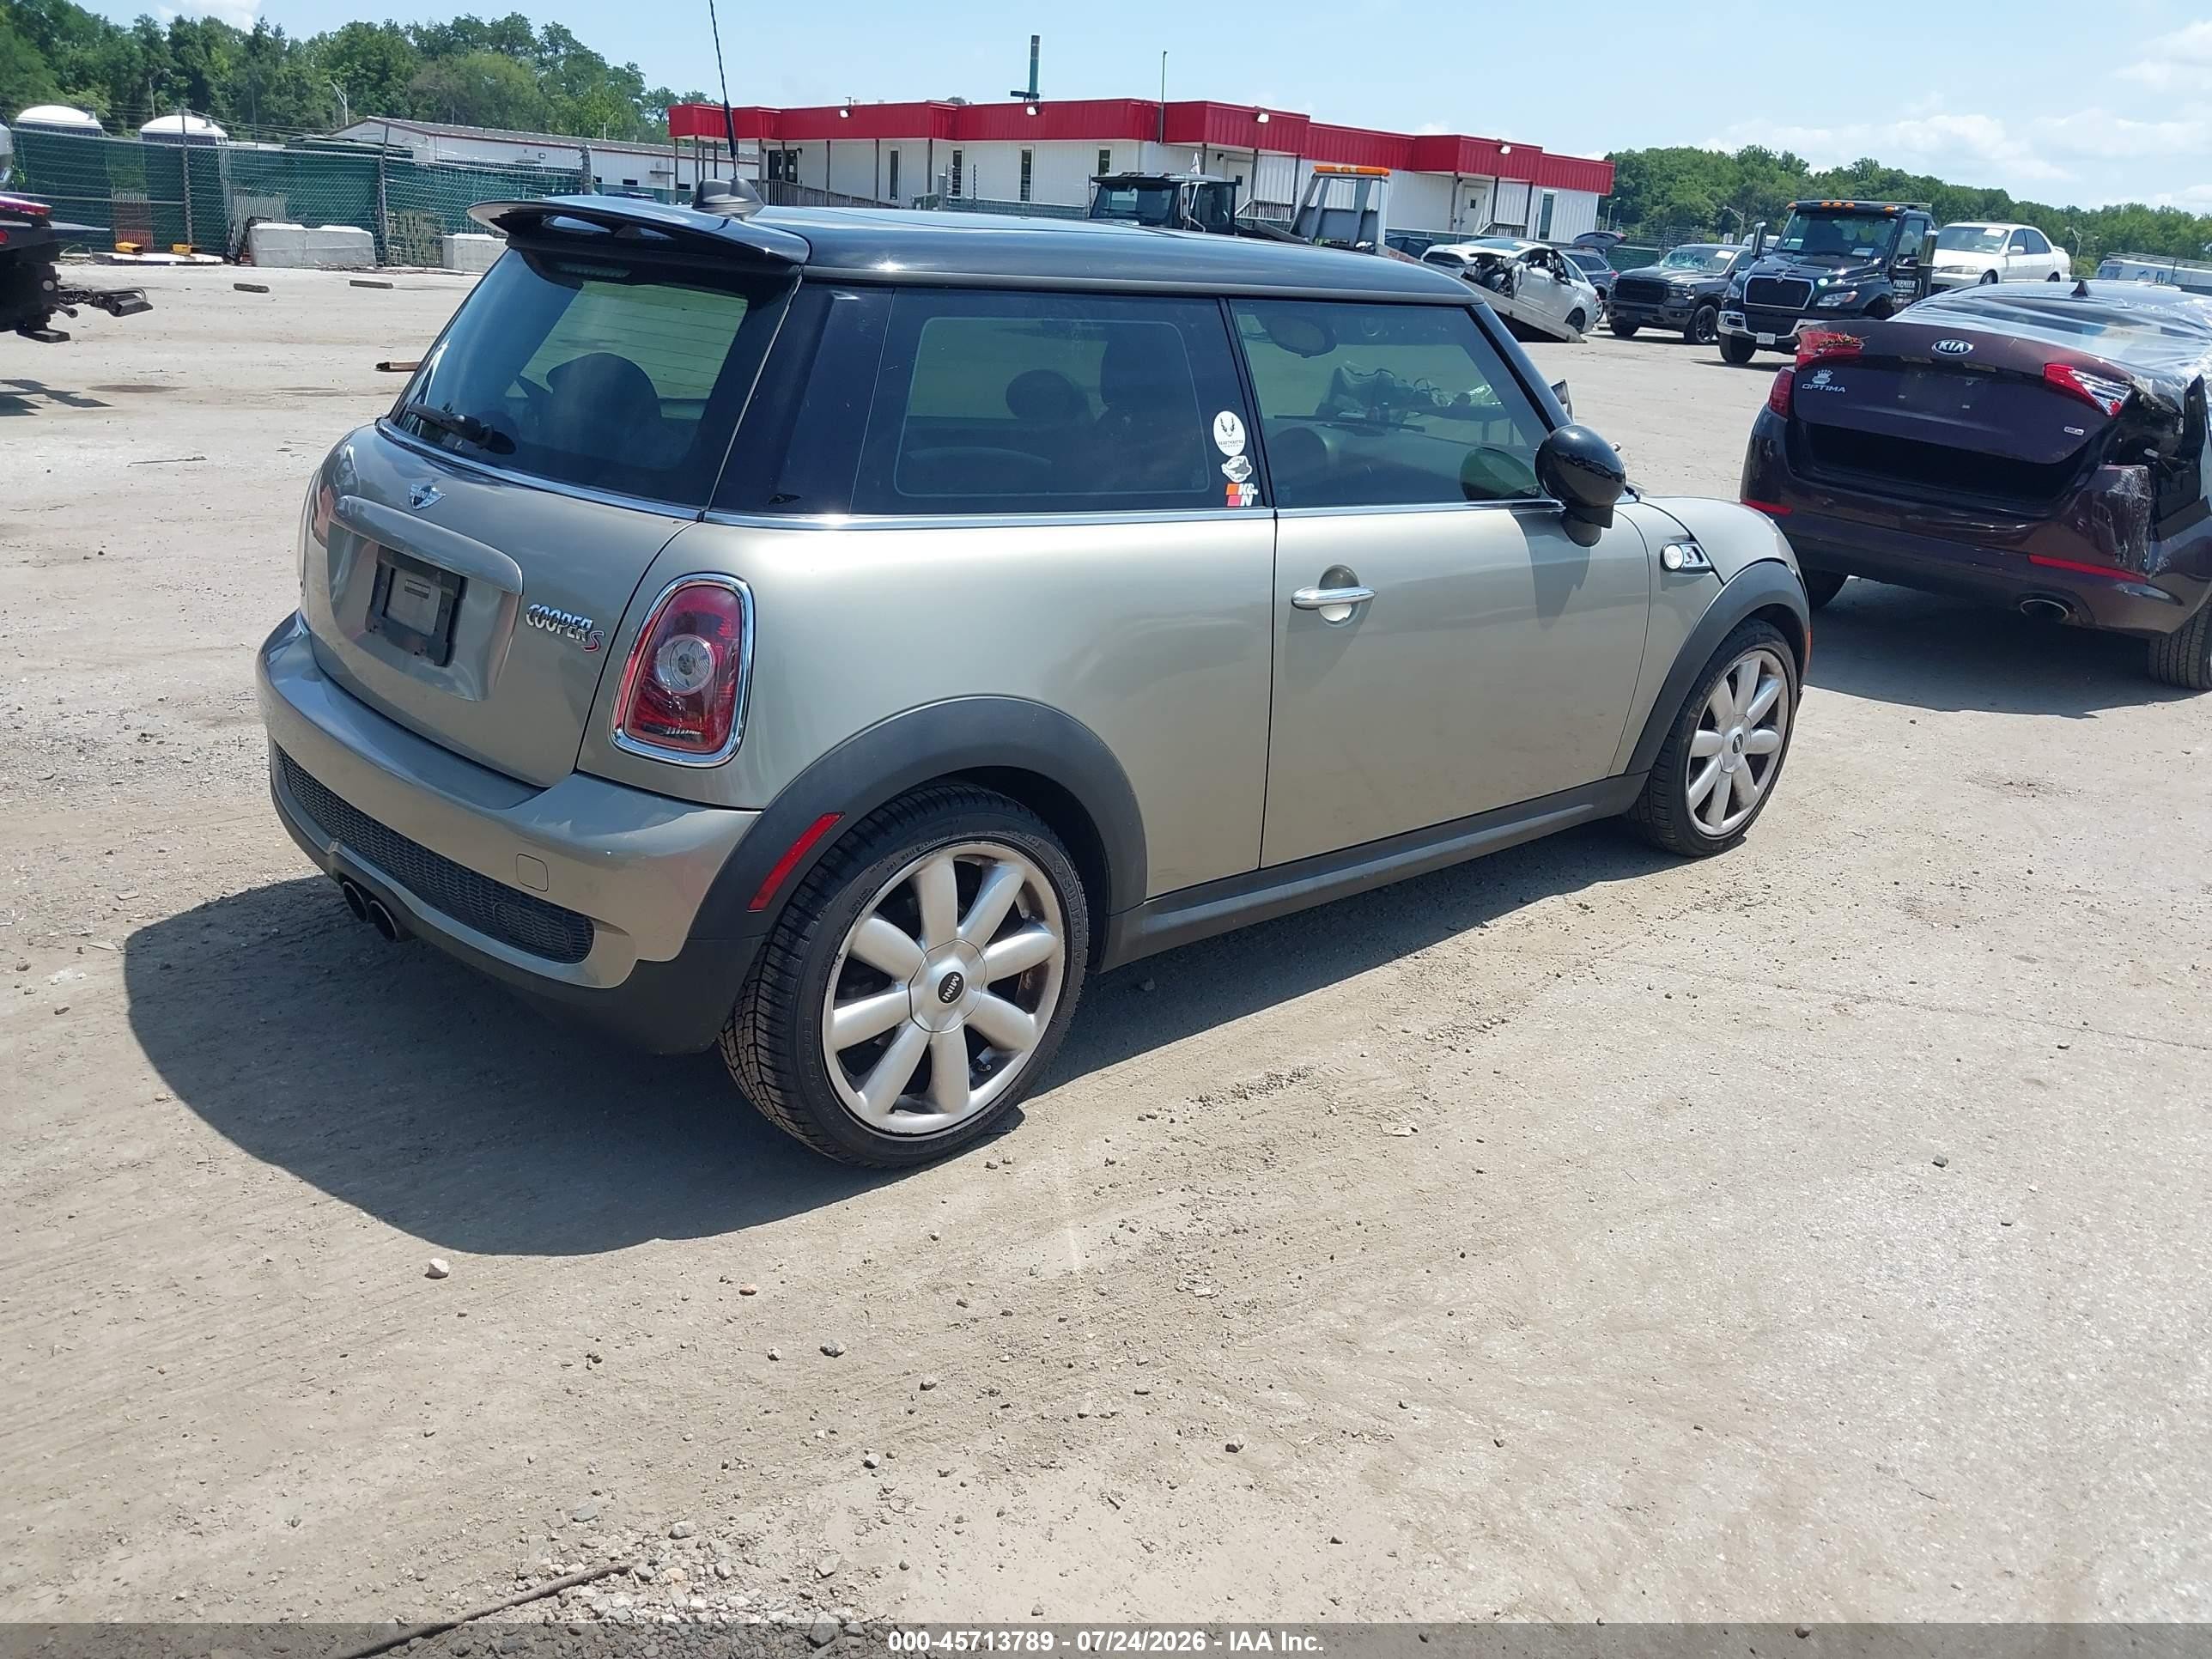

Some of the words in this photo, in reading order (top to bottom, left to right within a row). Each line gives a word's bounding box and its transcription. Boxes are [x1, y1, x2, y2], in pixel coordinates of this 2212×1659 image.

[1937, 341, 1965, 352] KIA
[1802, 383, 1846, 393] OPTIMA
[526, 604, 593, 642] COOPER
[583, 630, 605, 653] S
[942, 975, 960, 1001] MINI
